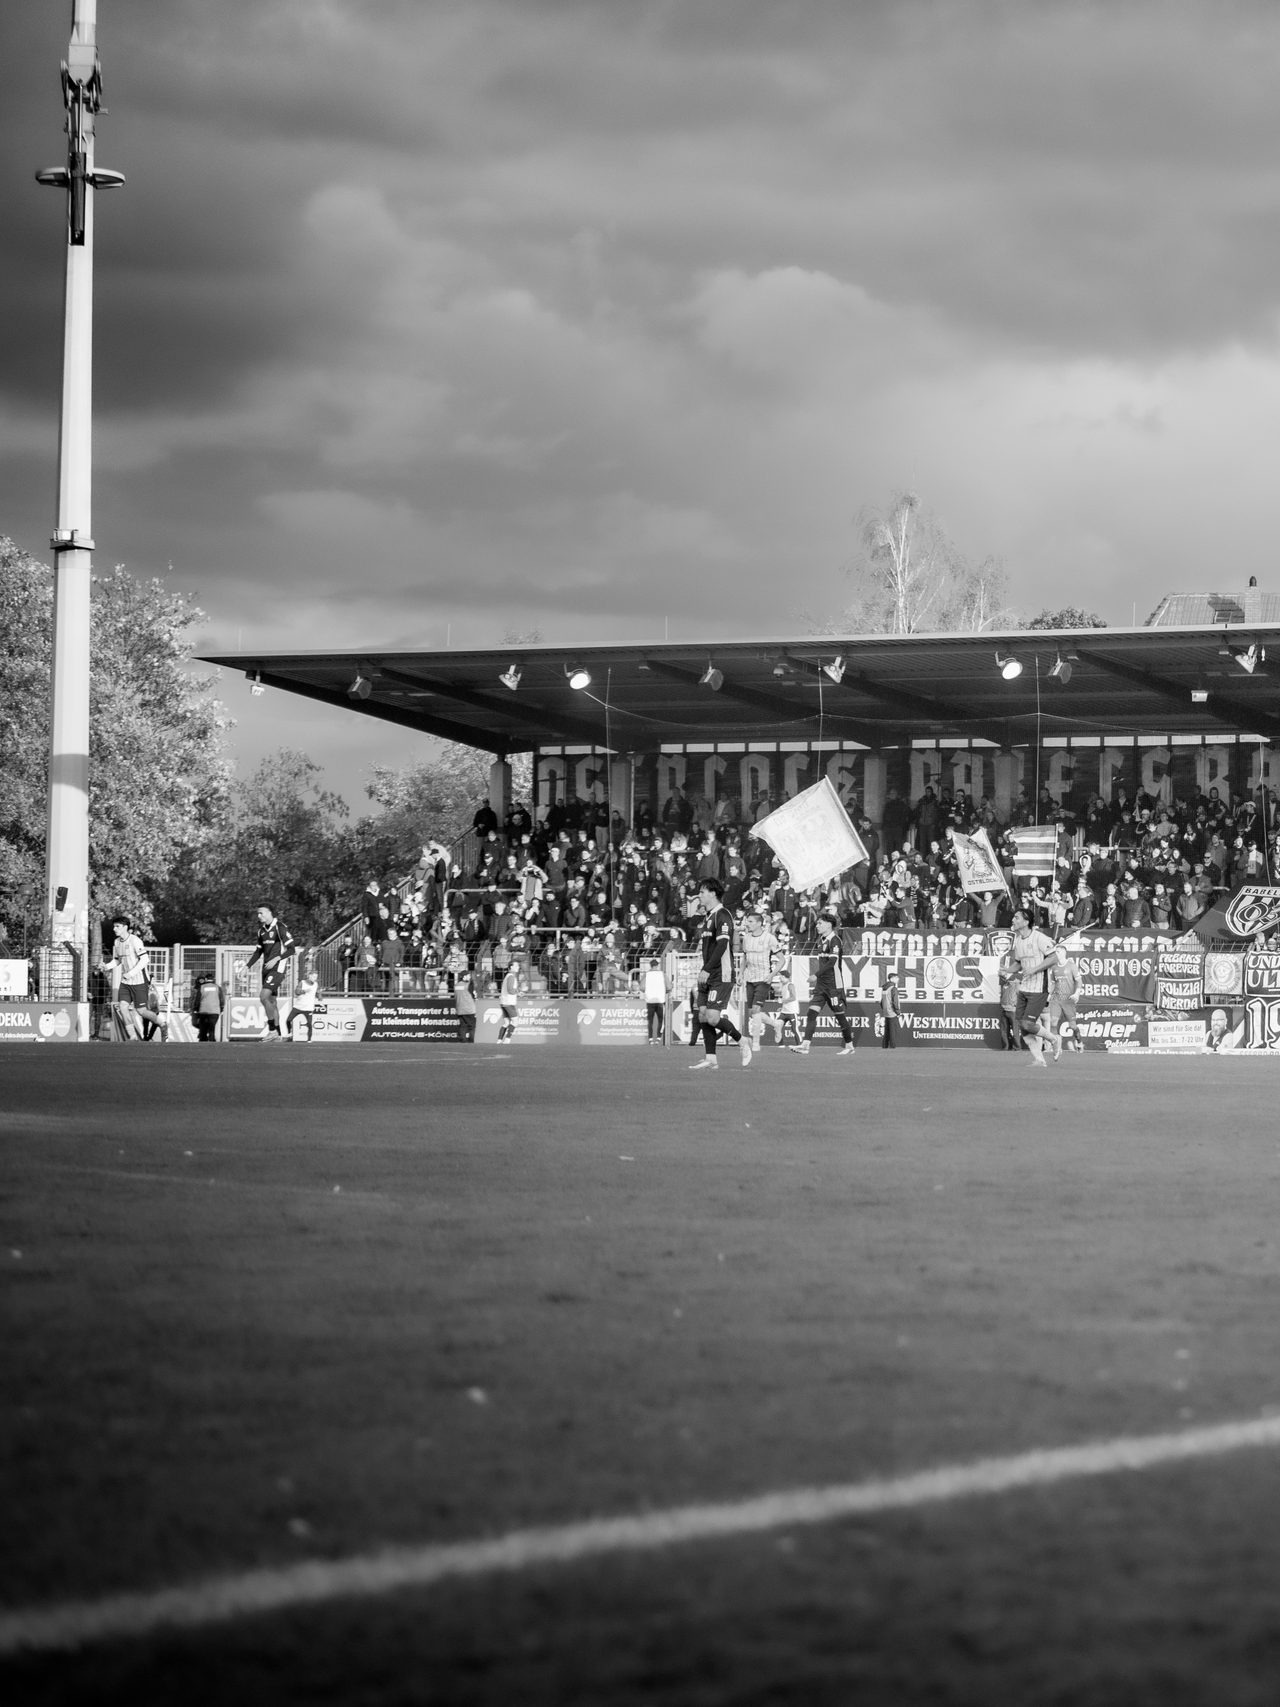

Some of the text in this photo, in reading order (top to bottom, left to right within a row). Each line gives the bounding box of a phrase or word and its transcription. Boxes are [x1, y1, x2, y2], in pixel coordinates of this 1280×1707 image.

[1159, 963, 1200, 975] FOREVER
[371, 1006, 397, 1016] Autos,
[397, 1006, 442, 1016] Transporter
[443, 1007, 449, 1015] &
[600, 1008, 648, 1017] TAVERPAC
[371, 1018, 382, 1026] zu
[382, 1016, 420, 1026] kleinsten
[529, 1017, 559, 1025] Potsdam
[600, 1017, 648, 1025] GmbH Potsda
[897, 1012, 1001, 1030] WESTMINSTER
[1103, 1038, 1141, 1049] Potsdam
